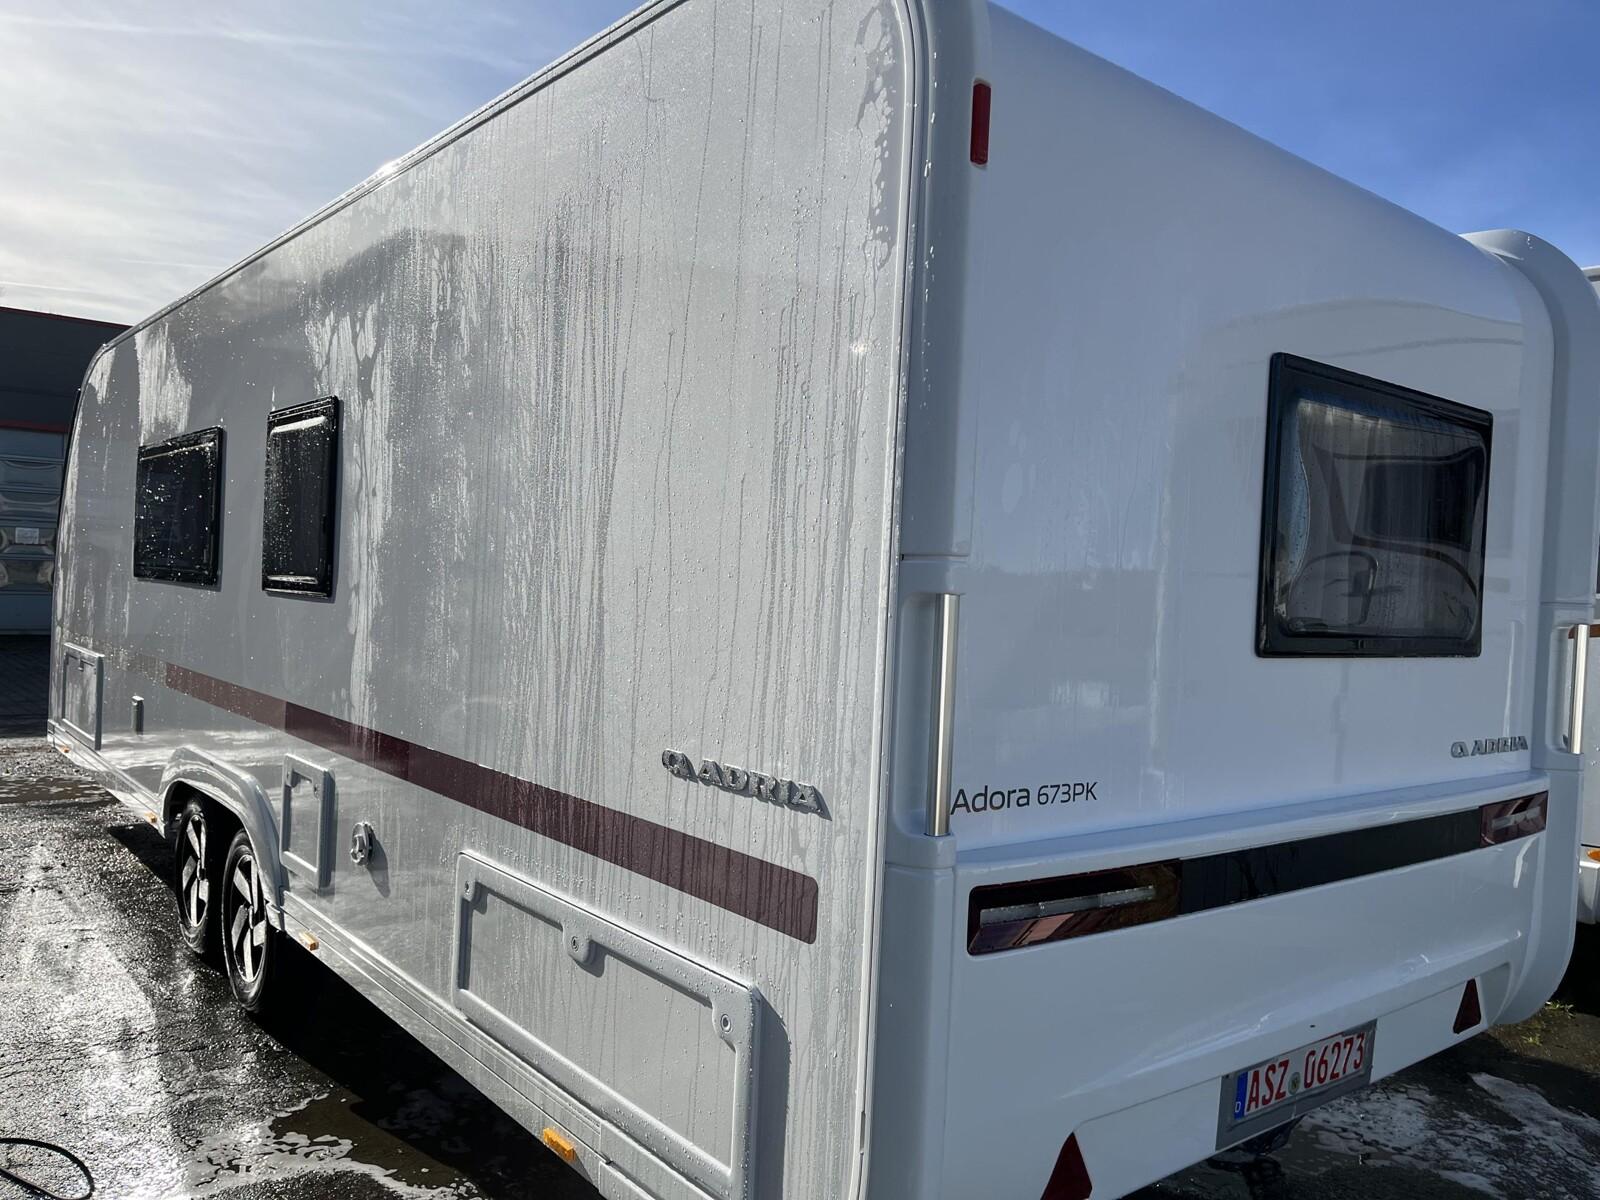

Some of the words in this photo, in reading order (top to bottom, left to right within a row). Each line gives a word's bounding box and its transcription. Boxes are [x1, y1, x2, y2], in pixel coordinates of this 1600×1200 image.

[950, 785, 1030, 815] Adora
[1037, 782, 1098, 805] 673PK
[1246, 1059, 1290, 1112] ASZ
[1304, 1032, 1366, 1088] 06273
